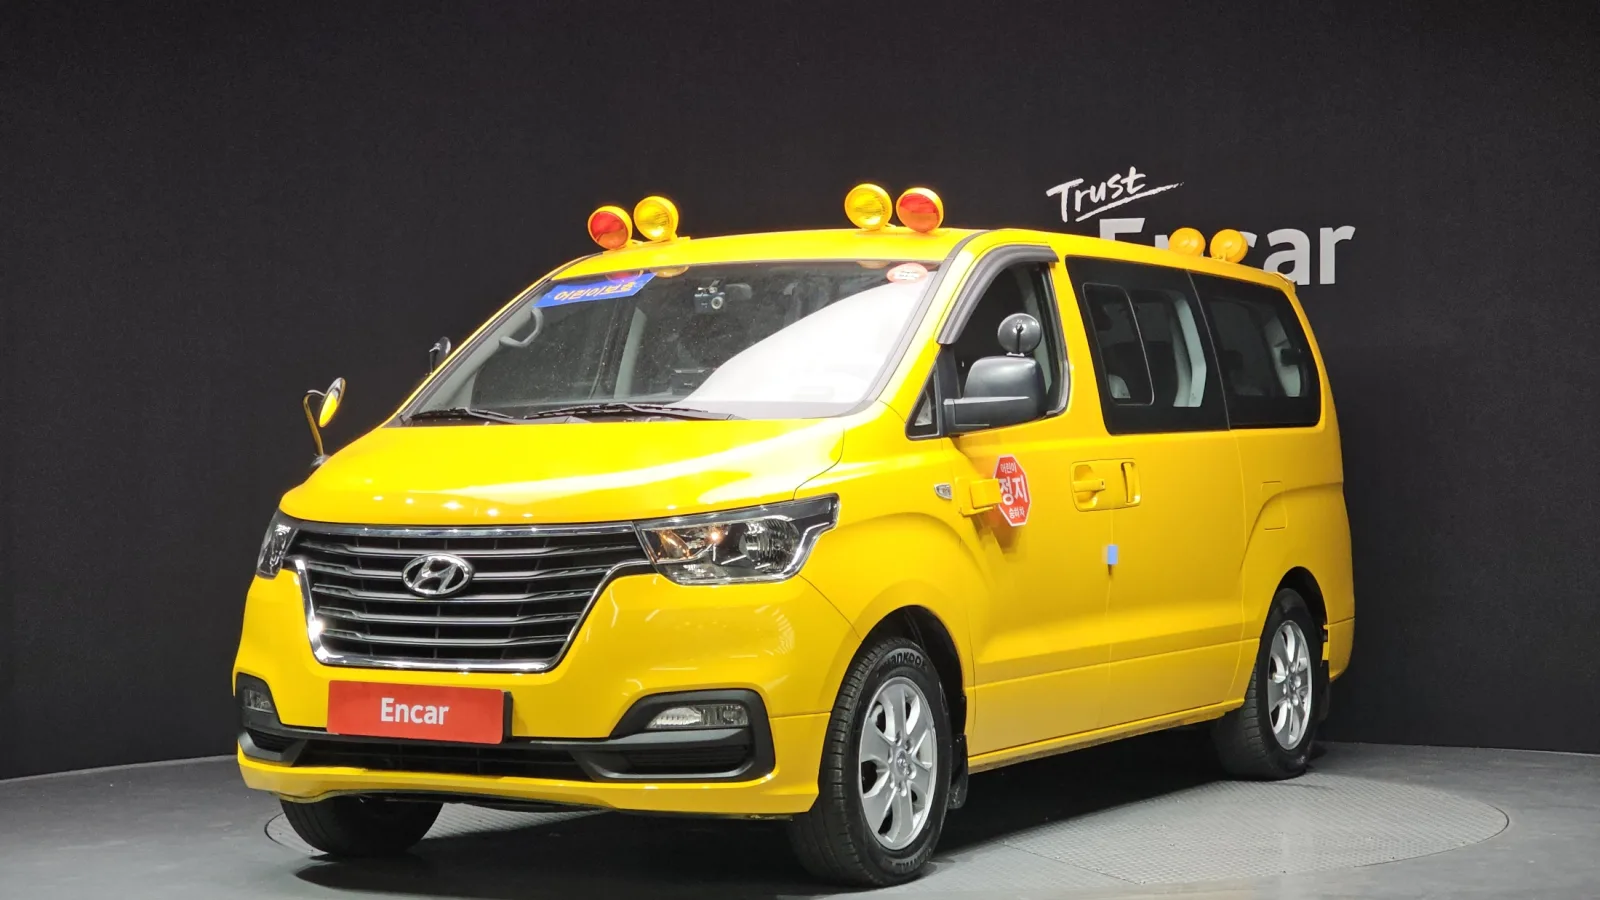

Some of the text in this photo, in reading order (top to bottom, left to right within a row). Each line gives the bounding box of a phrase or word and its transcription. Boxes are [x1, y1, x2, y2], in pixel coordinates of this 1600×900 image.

[1046, 166, 1147, 222] Trust
[999, 475, 1028, 506] 정지
[380, 697, 449, 725] Encar
